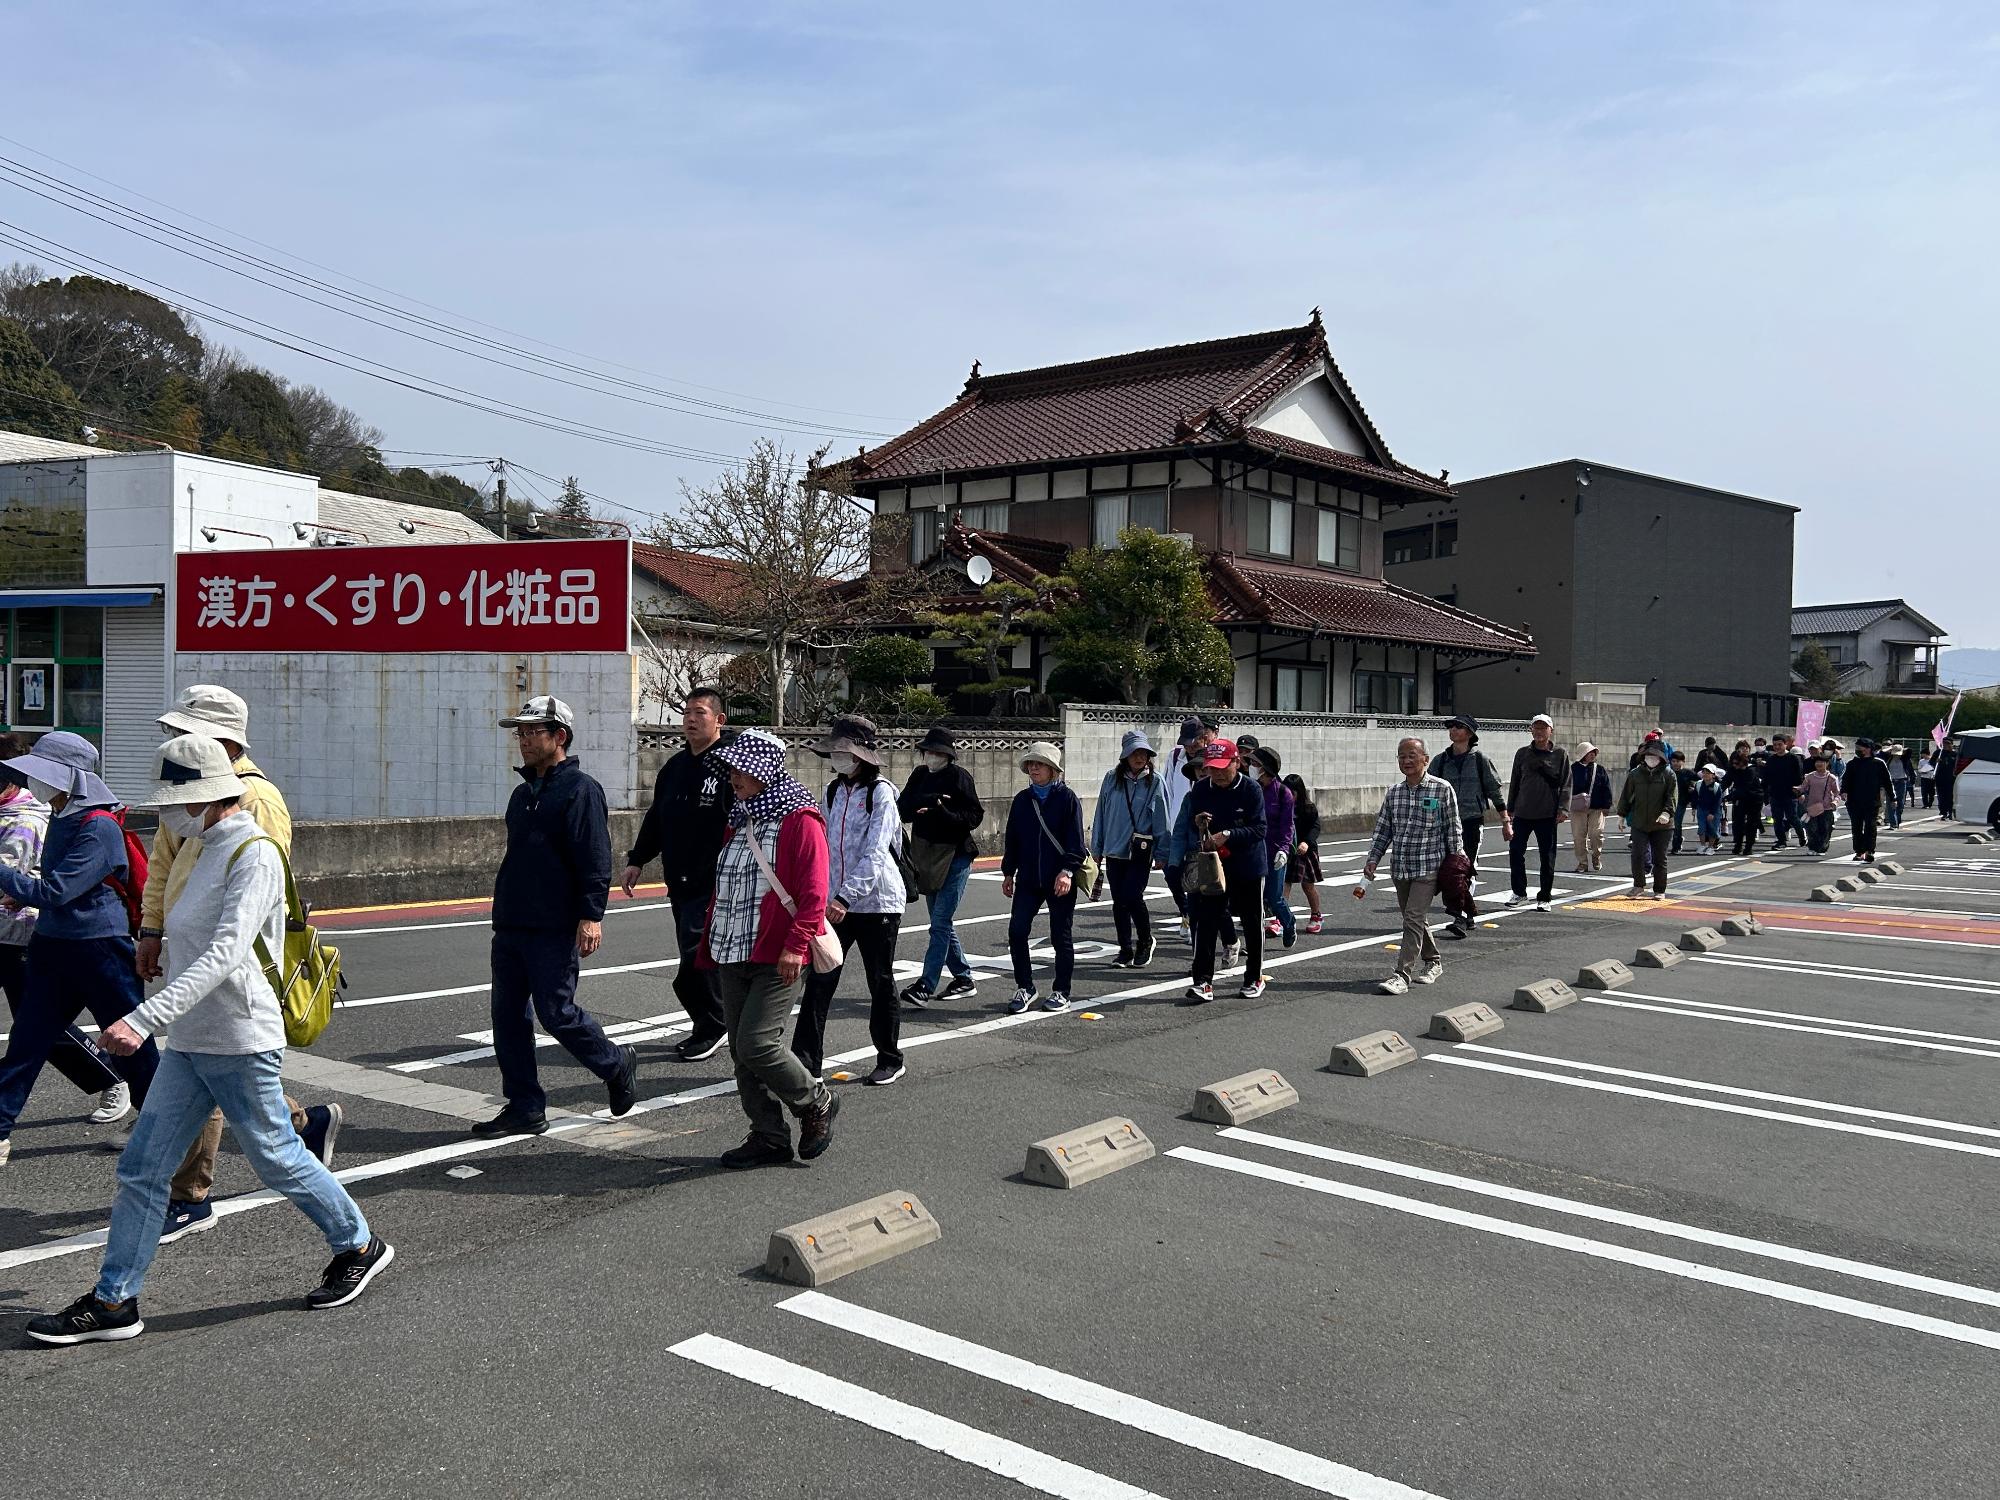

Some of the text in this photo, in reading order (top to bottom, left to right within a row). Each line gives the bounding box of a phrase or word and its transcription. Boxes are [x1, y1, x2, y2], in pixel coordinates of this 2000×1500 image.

[197, 567, 601, 629] 漢方・くすり・化粧品
[701, 776, 719, 795] NY
